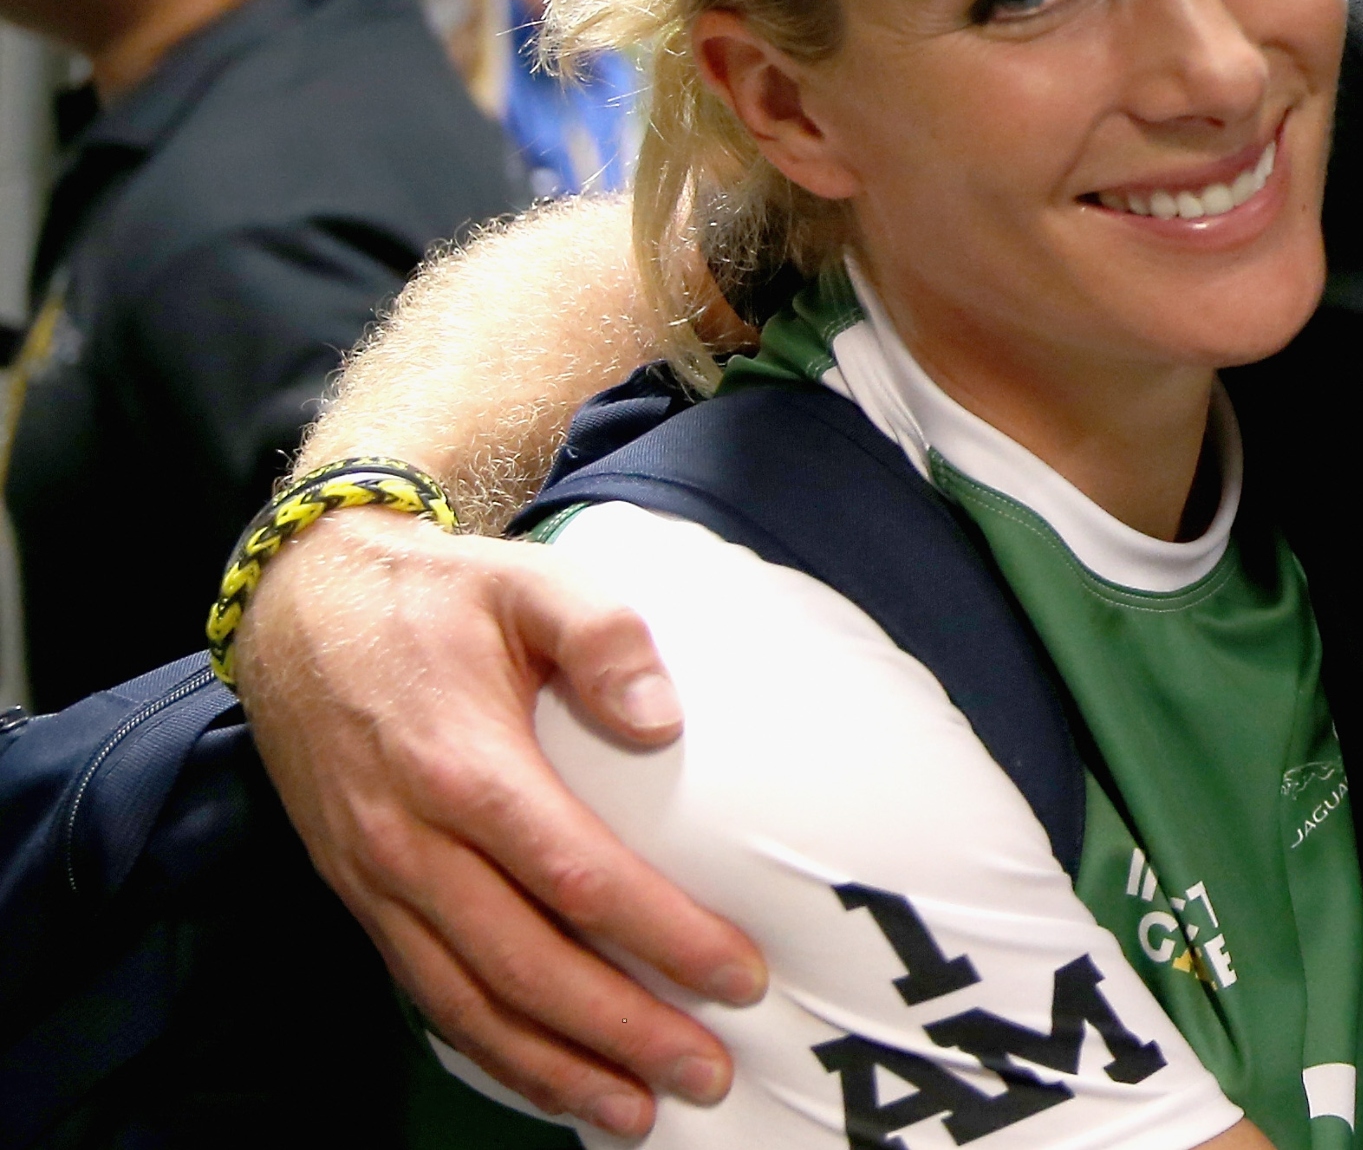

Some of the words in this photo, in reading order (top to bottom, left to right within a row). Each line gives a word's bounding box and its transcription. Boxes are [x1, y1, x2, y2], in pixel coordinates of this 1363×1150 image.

[1290, 776, 1348, 849] JAGUA
[830, 881, 982, 1007] I
[810, 952, 1169, 1150] AM
